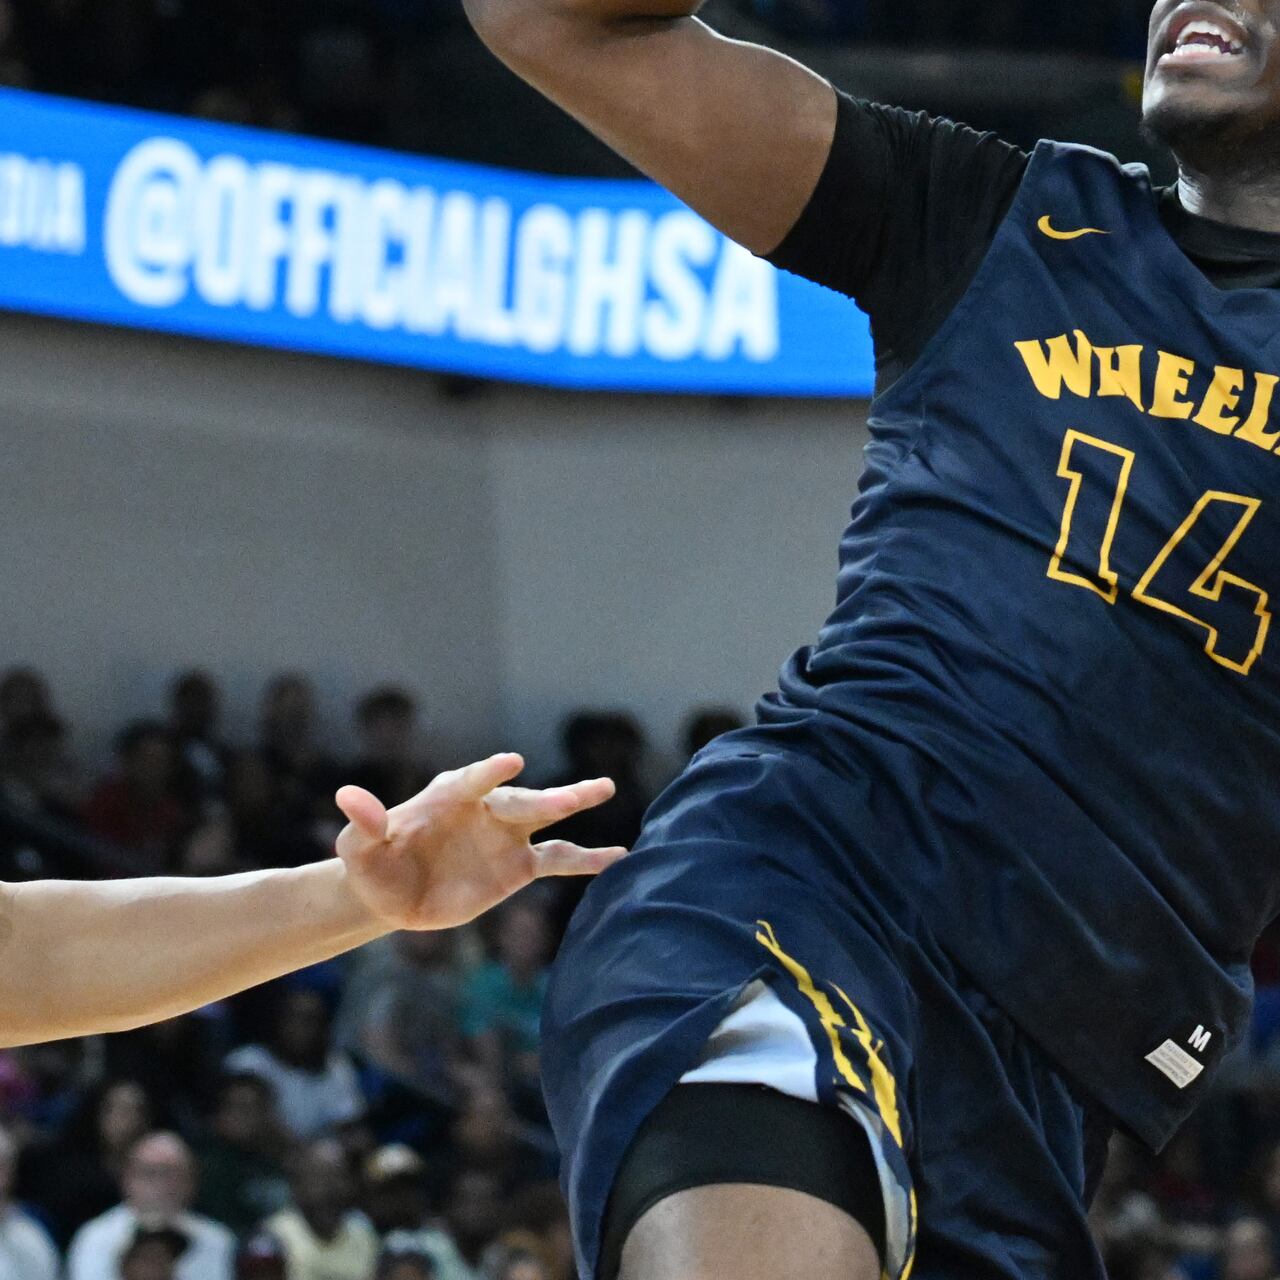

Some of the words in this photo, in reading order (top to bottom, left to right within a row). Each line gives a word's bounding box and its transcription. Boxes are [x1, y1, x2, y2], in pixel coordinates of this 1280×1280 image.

[103, 136, 779, 363] @OFFICIALGHSA
[1046, 428, 1272, 676] 14
[1187, 1024, 1212, 1052] M
